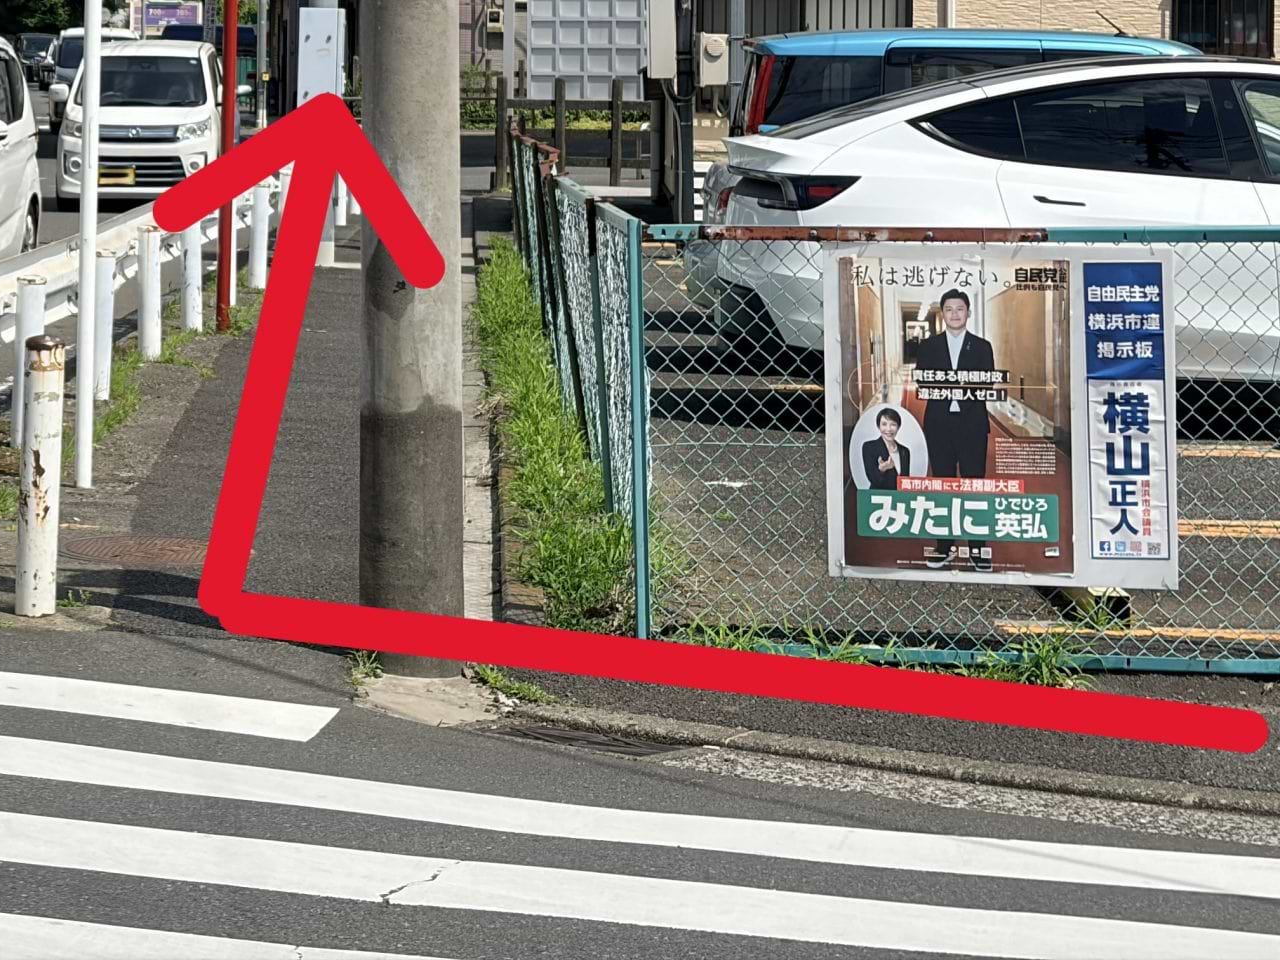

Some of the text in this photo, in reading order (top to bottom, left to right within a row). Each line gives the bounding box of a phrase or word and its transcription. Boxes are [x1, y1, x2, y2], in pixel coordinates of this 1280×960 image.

[851, 264, 1058, 288] 私は逃げない。 自民党
[1087, 284, 1160, 302] 自由民主党
[1087, 313, 1160, 330] 横浜市連
[1097, 341, 1153, 358] 掲示板
[1102, 392, 1150, 535] 横山正人
[994, 497, 1048, 511] ひでひろ
[868, 495, 990, 537] みたに
[994, 512, 1048, 539] 英弘
